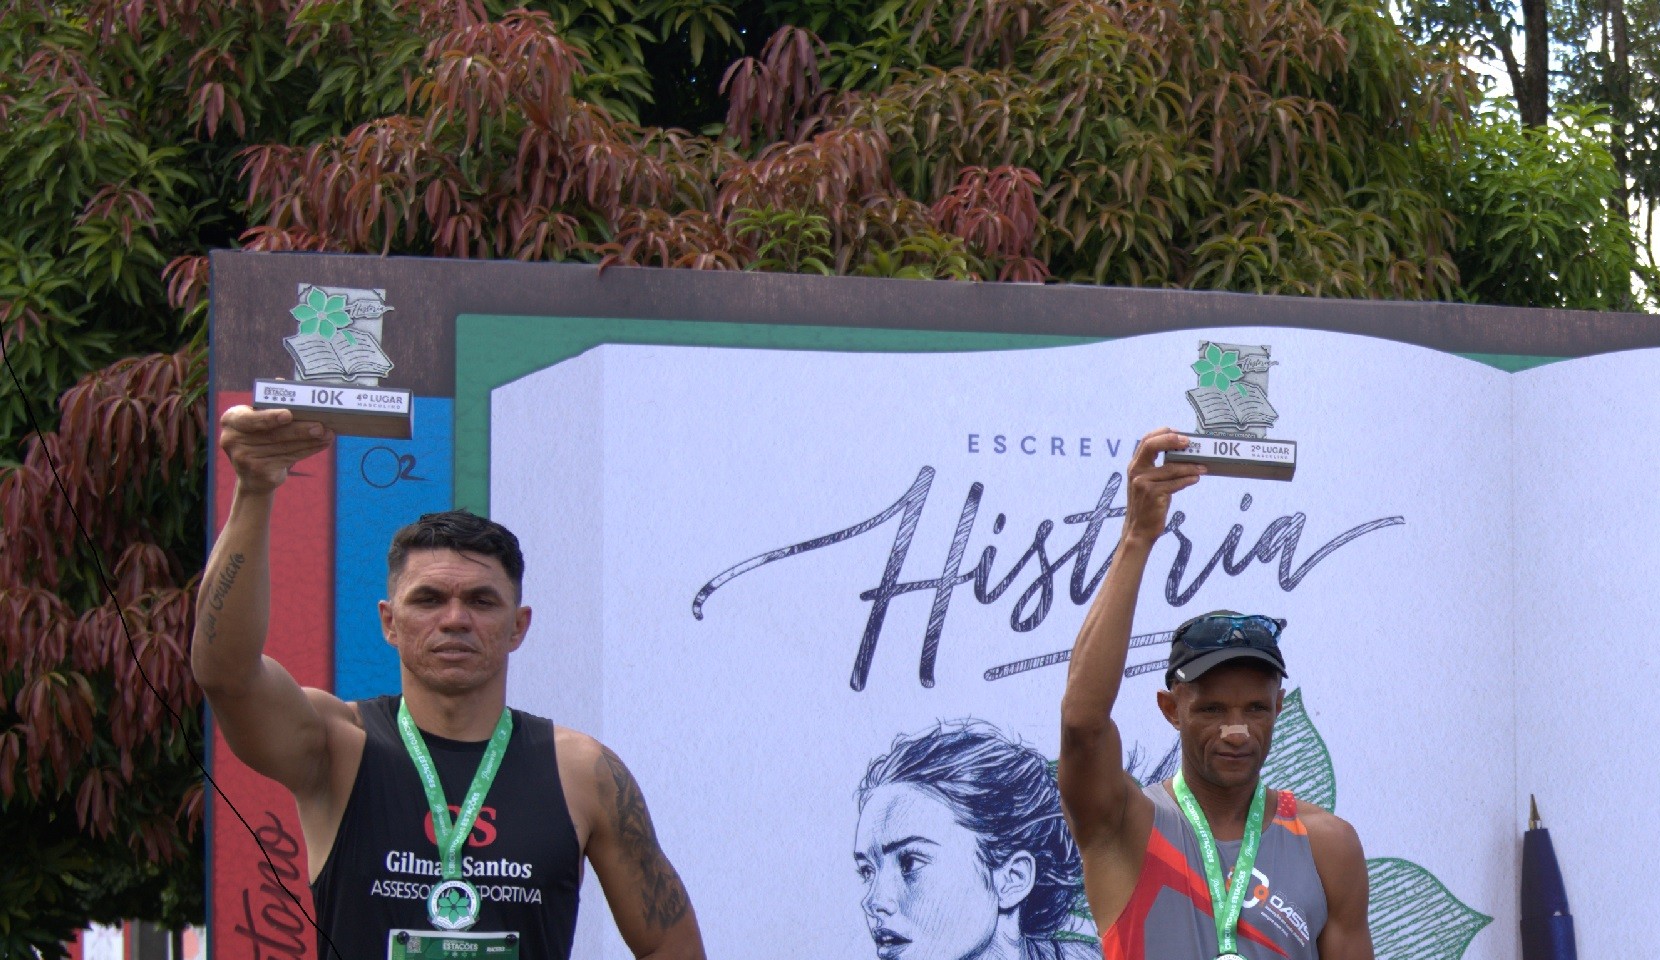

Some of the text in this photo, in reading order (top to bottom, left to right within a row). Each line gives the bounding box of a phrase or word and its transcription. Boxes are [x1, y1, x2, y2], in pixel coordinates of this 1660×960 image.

[311, 389, 344, 406] 10K
[370, 396, 403, 405] LUGAR
[1214, 442, 1240, 456] 10K
[1262, 445, 1290, 455] LUGAR
[692, 465, 1406, 692] Histria
[1200, 829, 1214, 863] ESTAÇÕES
[386, 850, 533, 879] Gilma Santos
[371, 879, 450, 901] ASSESSO
[466, 885, 542, 905] PORTIVA
[1232, 870, 1246, 904] ESTAÇÕES
